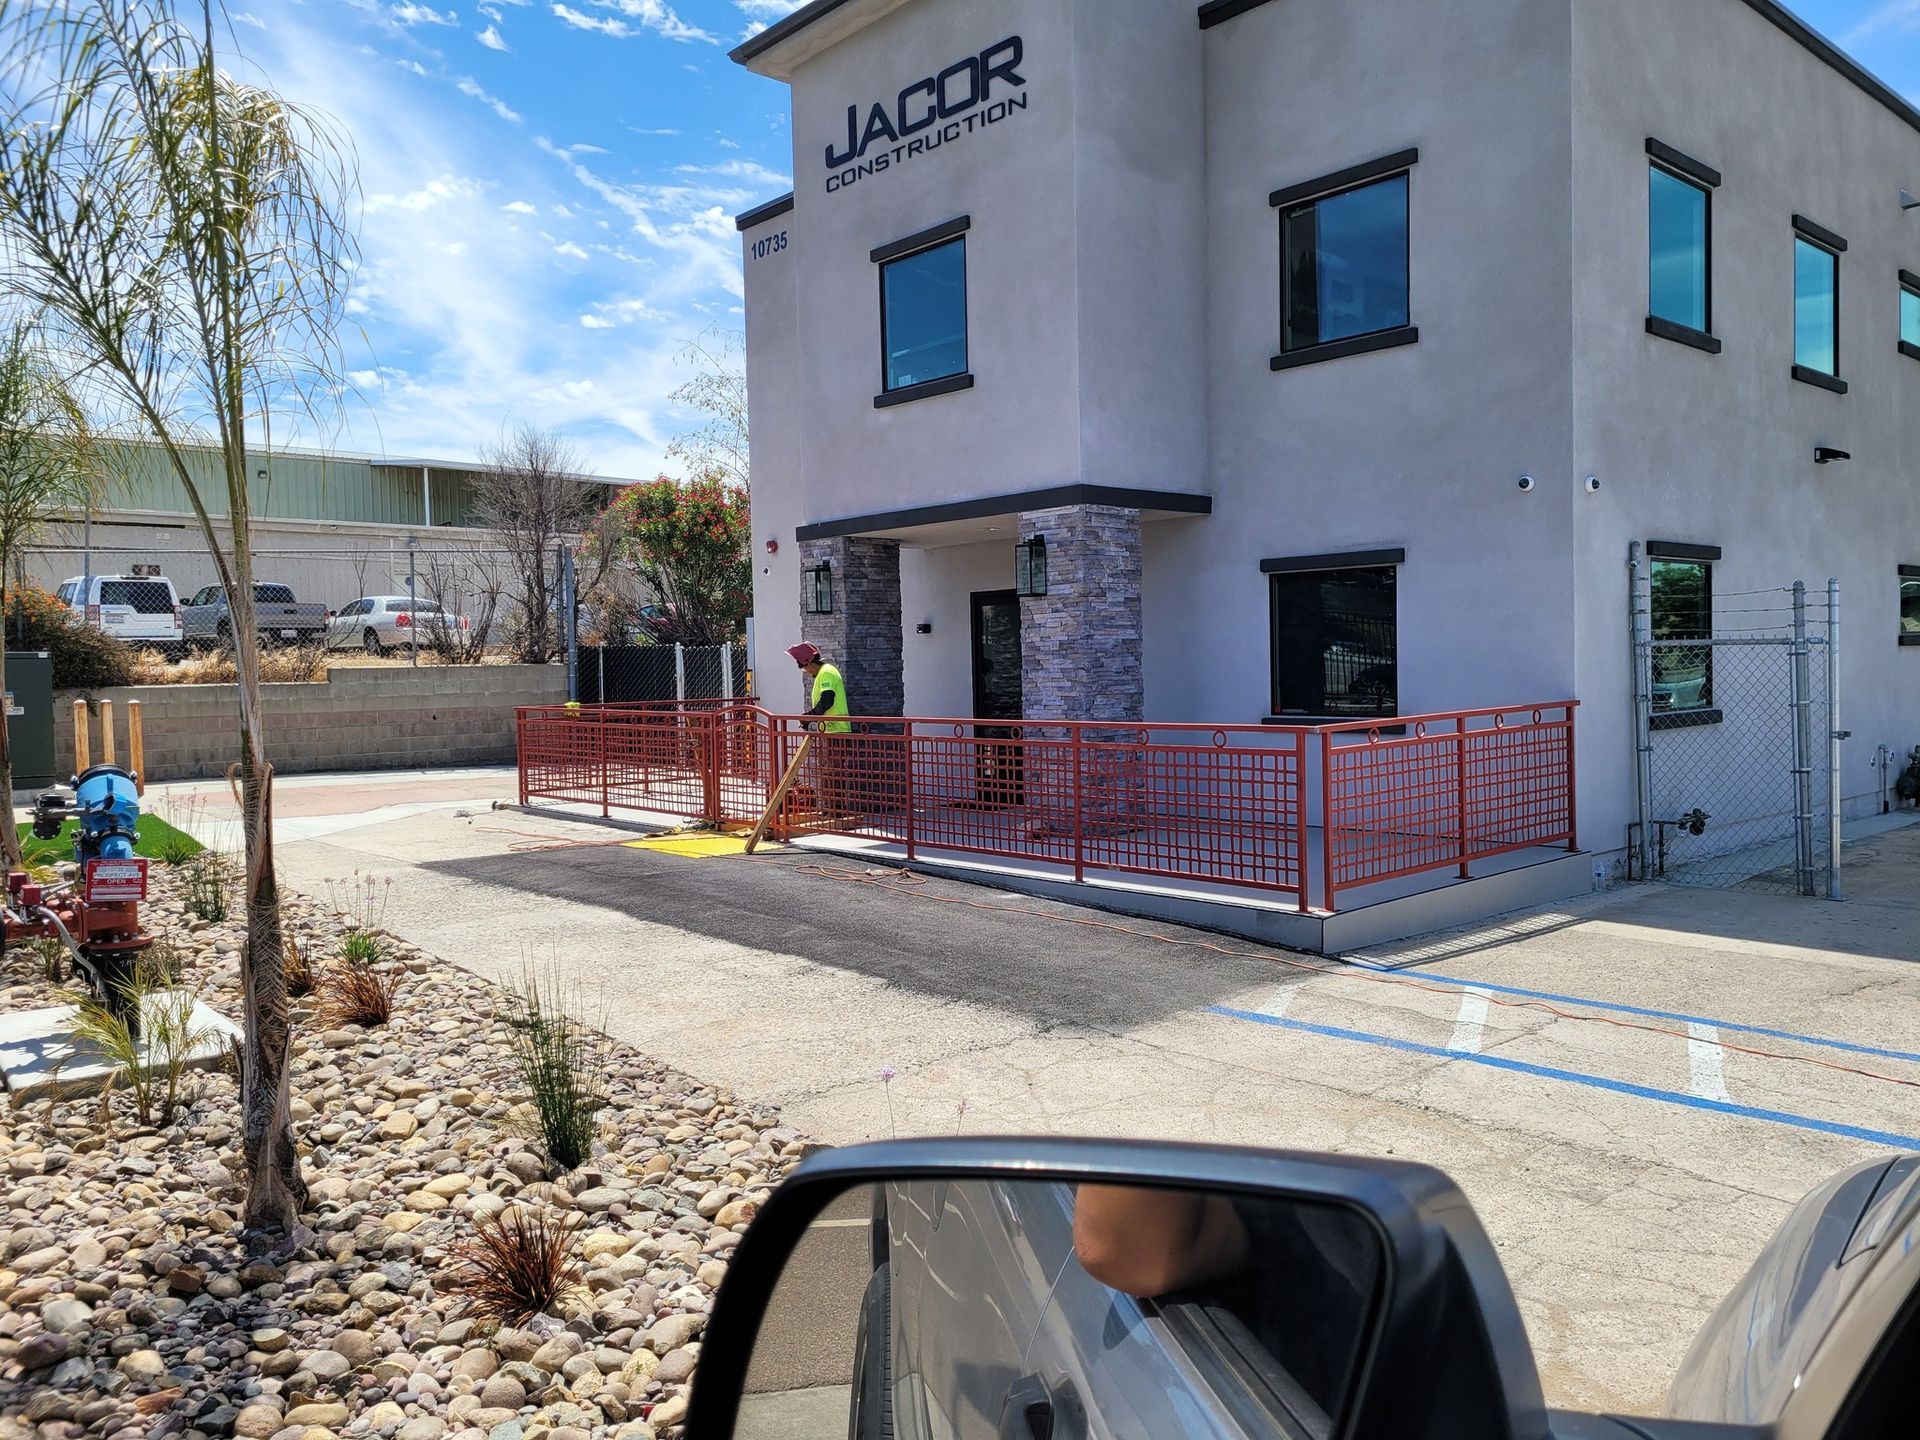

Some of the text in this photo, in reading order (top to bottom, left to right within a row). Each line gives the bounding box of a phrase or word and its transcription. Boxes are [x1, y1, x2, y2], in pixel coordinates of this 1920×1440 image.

[825, 36, 1026, 168] JACOR
[826, 92, 1027, 193] CONSTRUCTION
[751, 230, 788, 260] 10735
